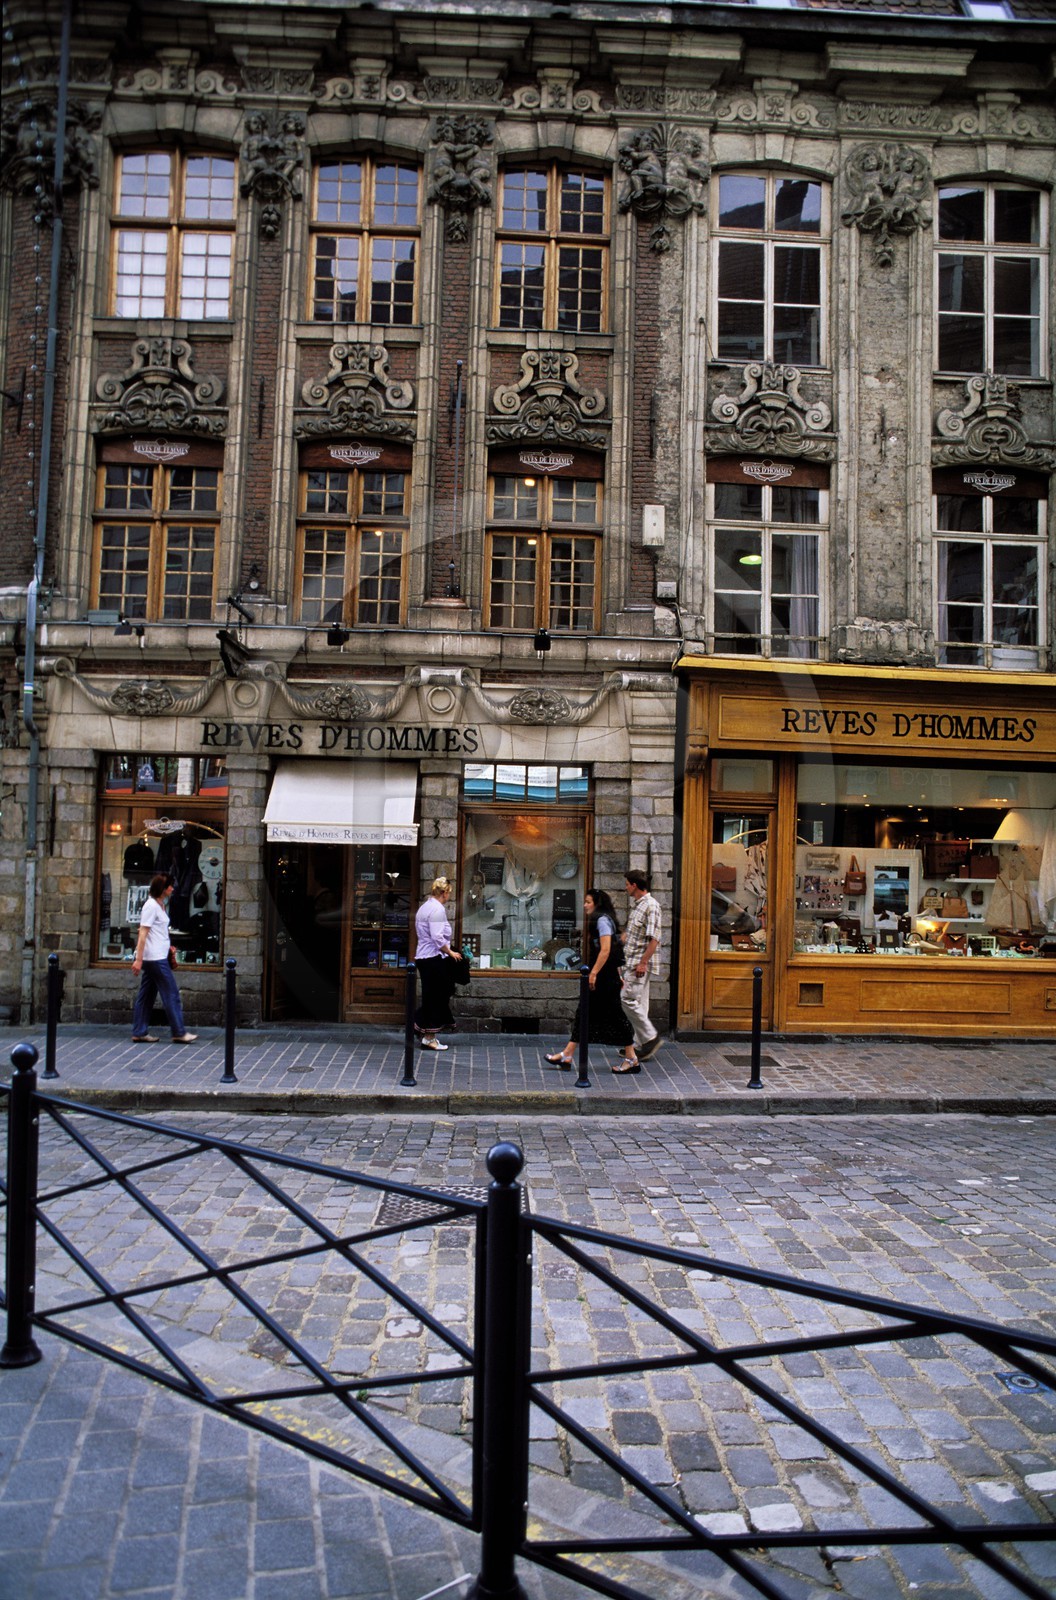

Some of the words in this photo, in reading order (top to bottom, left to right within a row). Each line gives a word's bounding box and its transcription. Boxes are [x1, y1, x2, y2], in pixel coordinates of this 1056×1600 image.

[163, 446, 189, 454] FEMMES
[549, 457, 573, 465] FEMMES
[781, 708, 877, 736] REVES
[892, 713, 1037, 742] D'HOMMES
[200, 721, 303, 750] REVES
[318, 725, 479, 753] D'HOMMES
